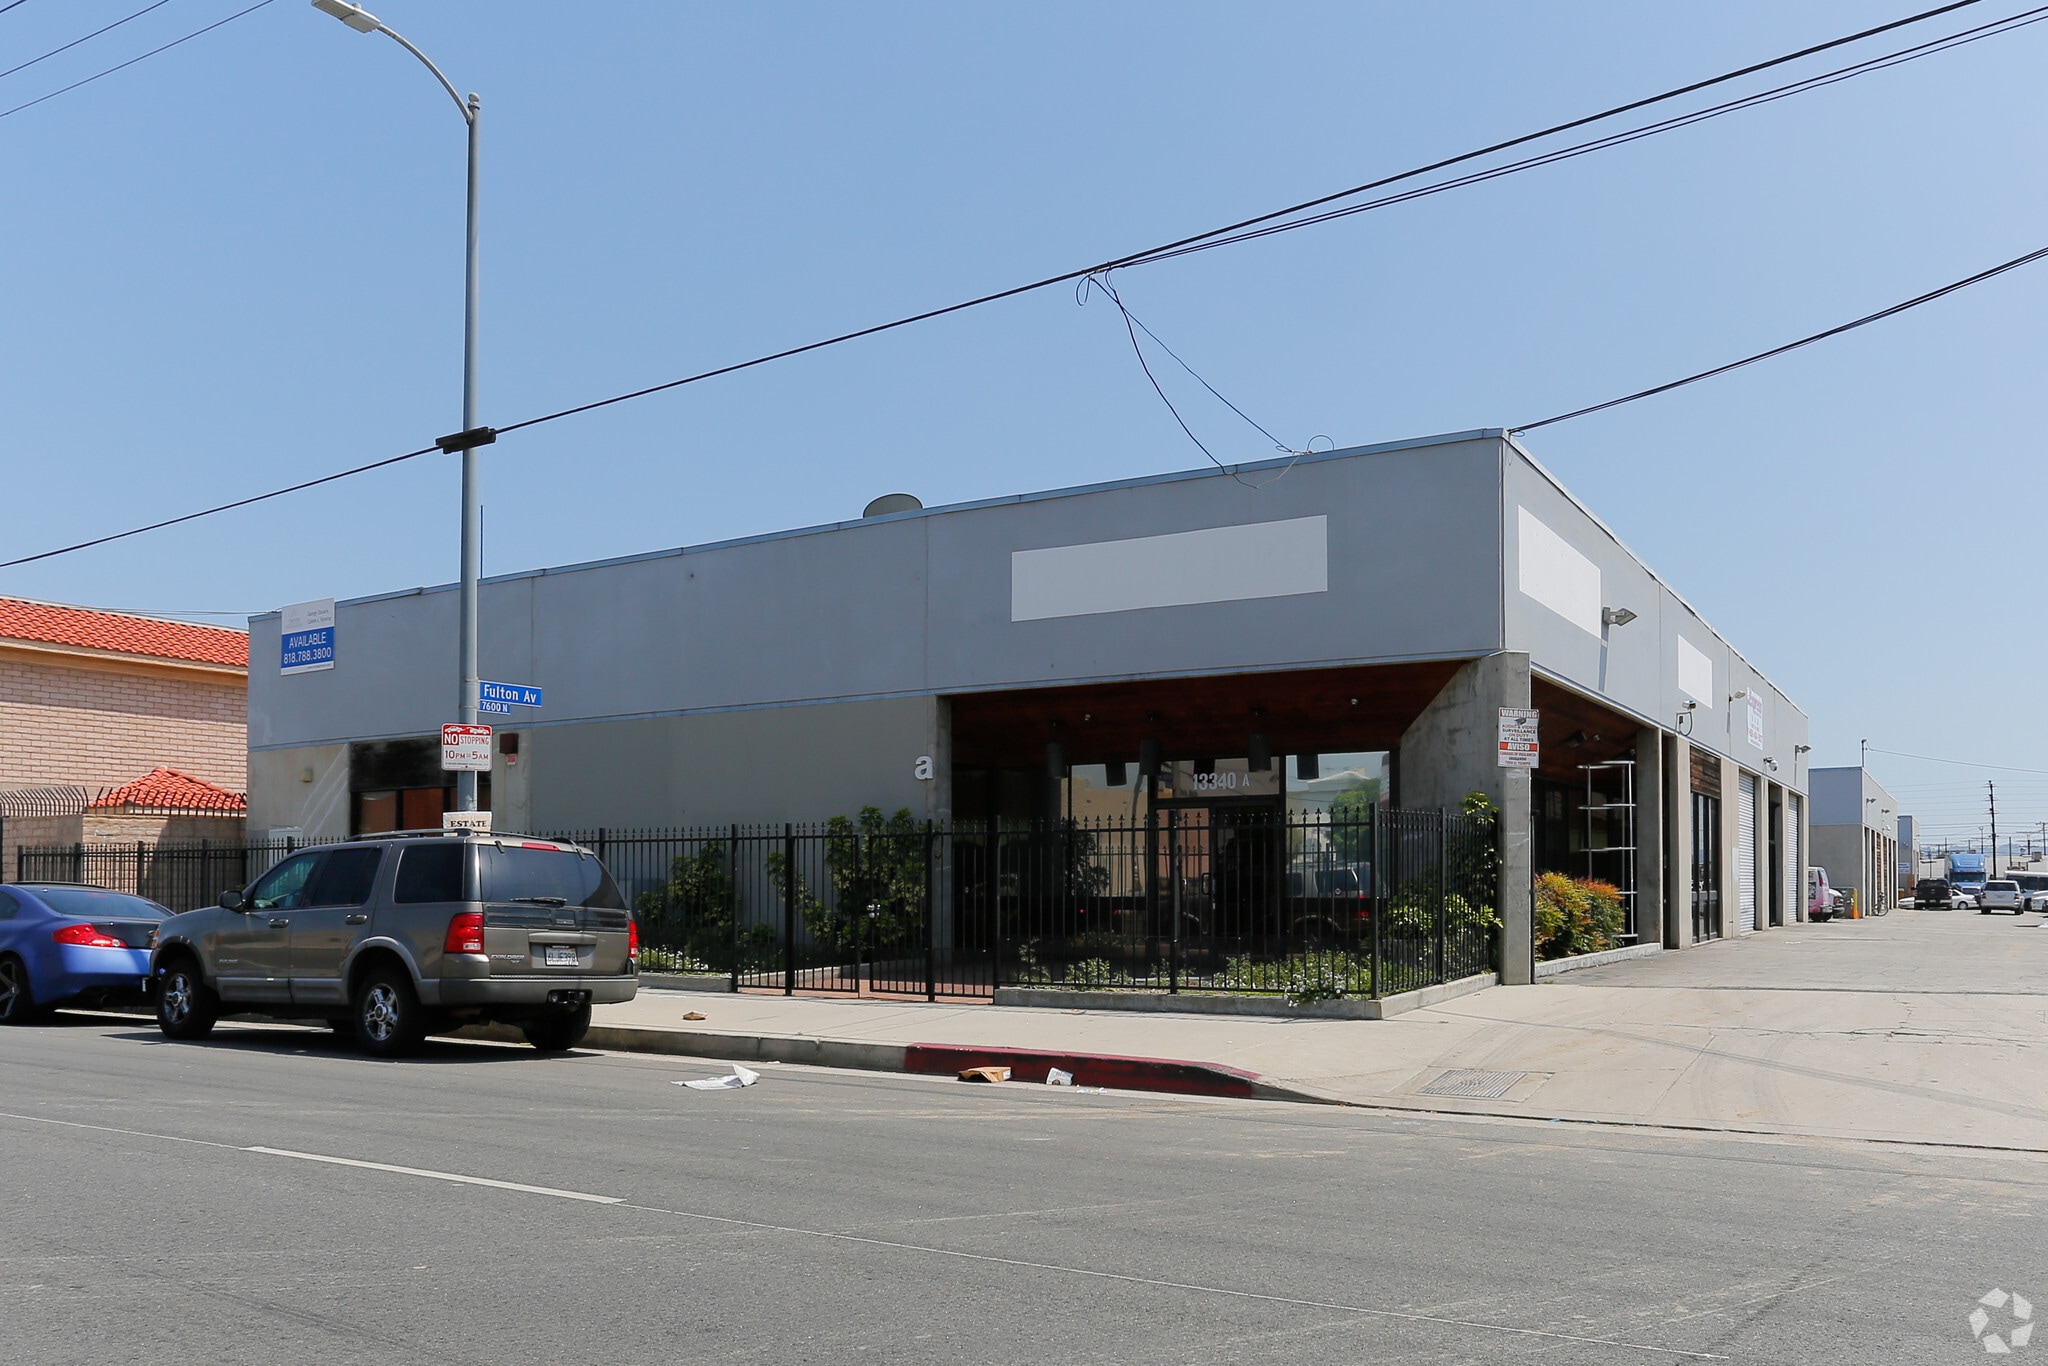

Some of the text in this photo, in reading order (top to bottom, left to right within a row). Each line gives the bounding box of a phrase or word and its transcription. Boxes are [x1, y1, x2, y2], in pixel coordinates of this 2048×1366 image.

[289, 632, 327, 649] AVAILABLE
[283, 647, 332, 664] 818.788.3800
[484, 684, 537, 703] Fulton Av
[481, 701, 508, 712] 7600 N
[1501, 709, 1538, 718] WARNING
[444, 733, 490, 746] NO STOPPING
[1507, 742, 1530, 751] AVISO
[914, 755, 933, 780] a
[1193, 772, 1250, 790] 13340 A
[450, 820, 487, 828] ESTATE
